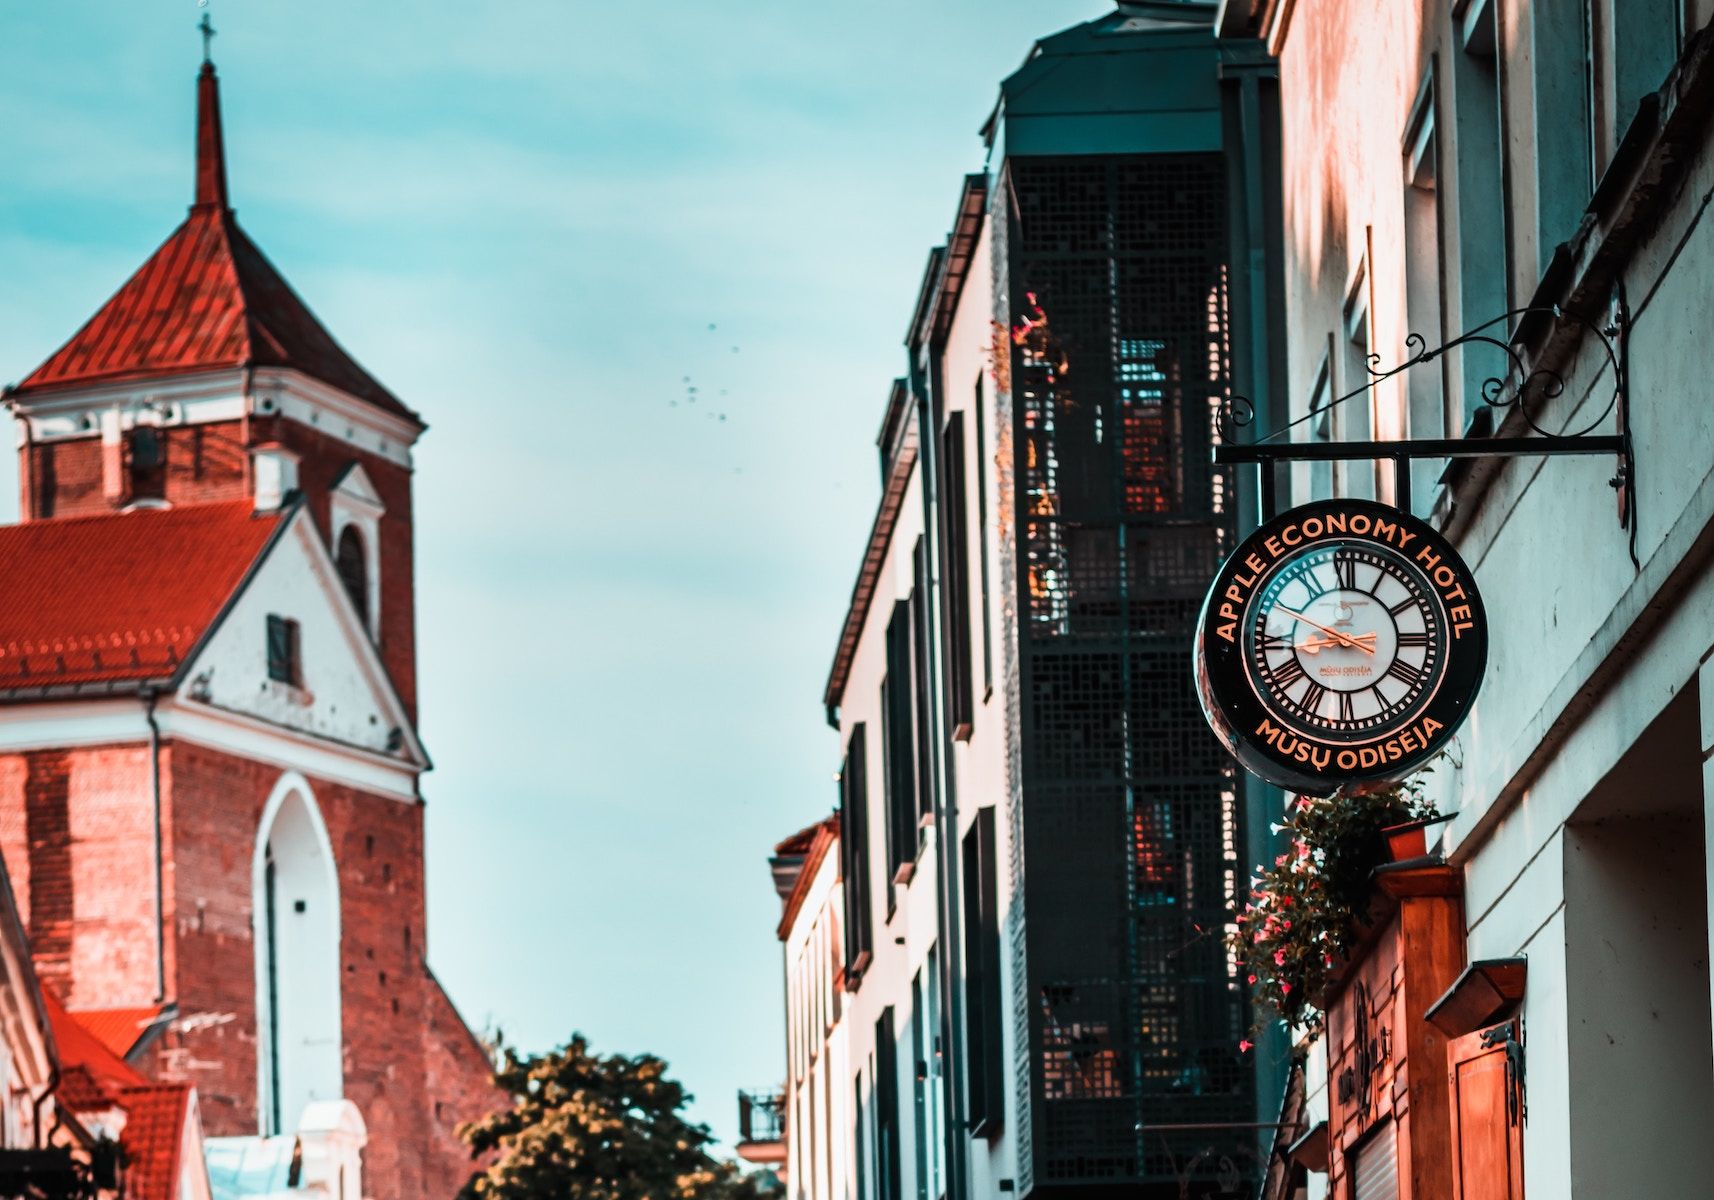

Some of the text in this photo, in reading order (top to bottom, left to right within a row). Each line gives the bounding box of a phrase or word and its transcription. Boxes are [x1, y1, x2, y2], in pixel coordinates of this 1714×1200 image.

[1216, 512, 1474, 643] APPLE ECONOMY HOTEL
[1255, 716, 1444, 771] MŪSŲ ODISĖJA
